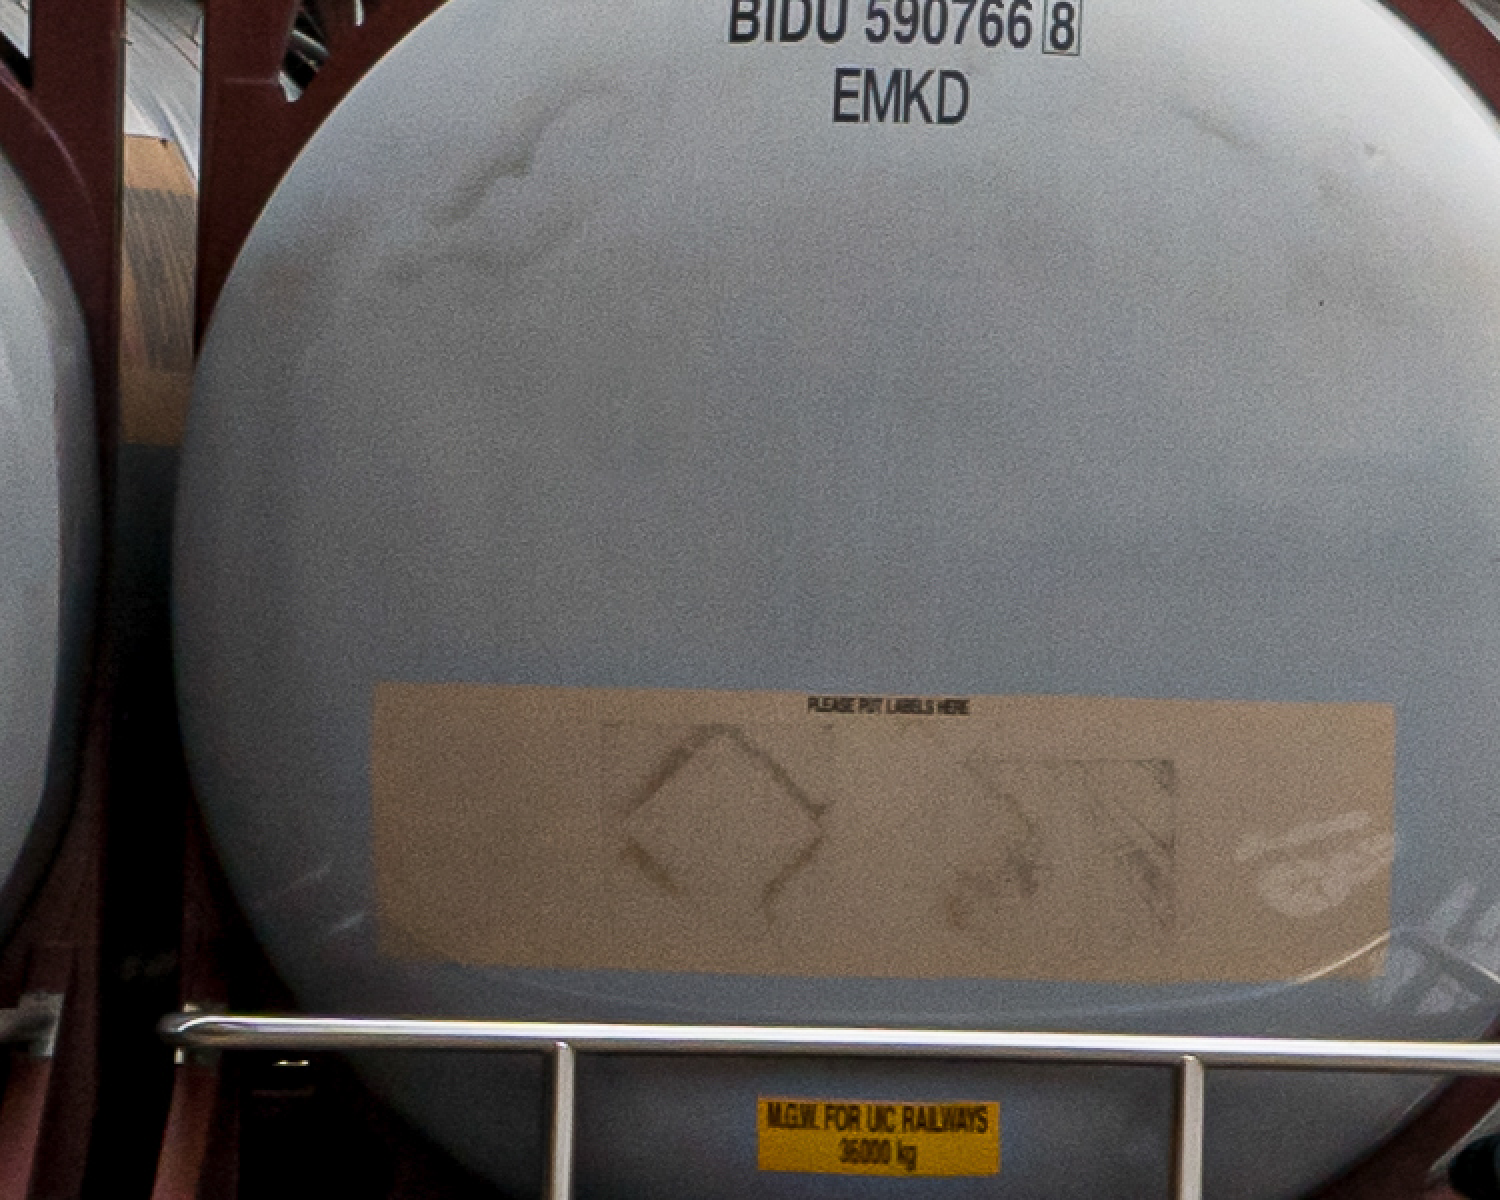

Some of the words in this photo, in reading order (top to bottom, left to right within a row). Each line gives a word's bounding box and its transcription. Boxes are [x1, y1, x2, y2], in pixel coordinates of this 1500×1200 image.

[1047, 0, 1078, 53] 8
[832, 67, 970, 125] EMKD
[808, 696, 855, 713] PLEASE
[859, 696, 883, 714] PUT
[824, 1104, 863, 1132] FOR
[868, 1105, 896, 1133] UIC
[902, 1105, 989, 1134] RAILWAYS
[896, 1137, 917, 1172] kg
